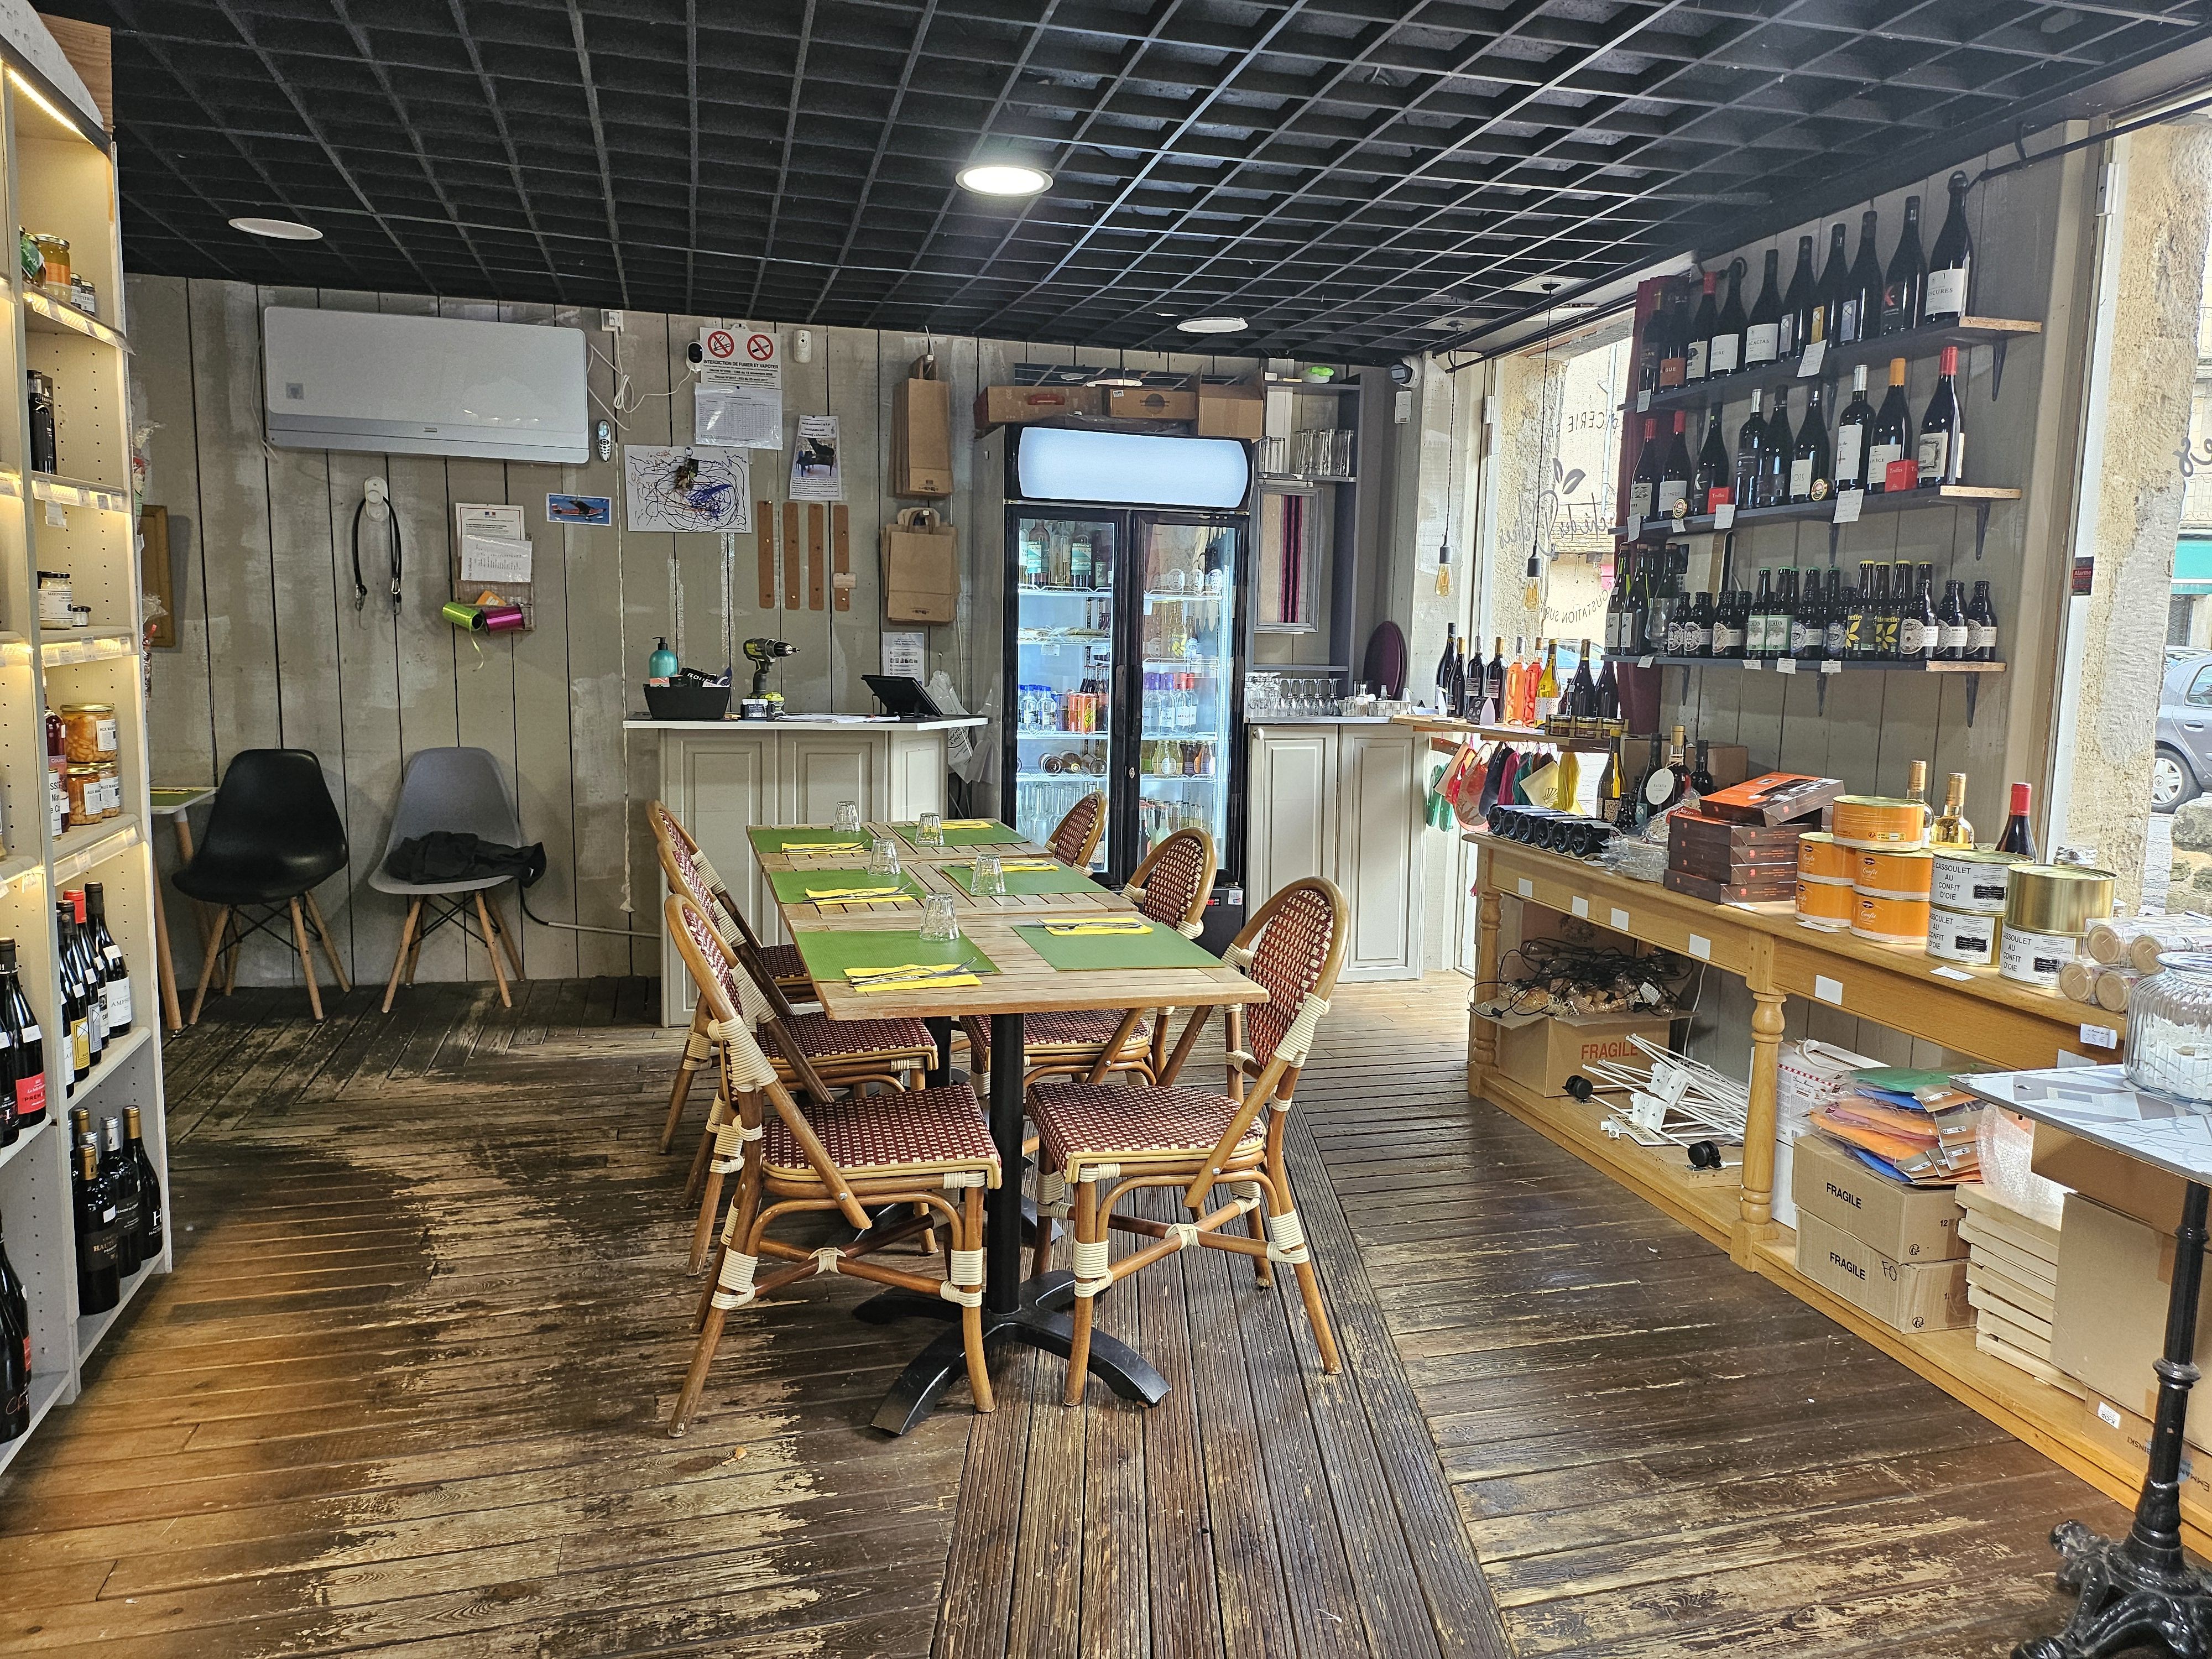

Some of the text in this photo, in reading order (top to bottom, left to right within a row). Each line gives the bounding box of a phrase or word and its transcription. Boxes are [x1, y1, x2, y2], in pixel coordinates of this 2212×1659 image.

[1863, 866, 1879, 877] Confit
[1936, 862, 1971, 874] CASSOULET
[1938, 881, 1961, 891] CONFIT
[1940, 891, 1957, 900] D'OIE
[1860, 910, 1877, 920] Confit
[1928, 931, 1944, 941] CONFIT
[1929, 941, 1941, 950] D'OIE
[2003, 951, 2022, 963] CONFIT
[2004, 962, 2017, 972] D'OIE
[2085, 1033, 2096, 1043] 25
[1581, 1041, 1637, 1060] FRAGILE
[1827, 1182, 1861, 1209] FRAGILE
[1830, 1251, 1866, 1281] FRAGILE
[1881, 1260, 1897, 1281] FO
